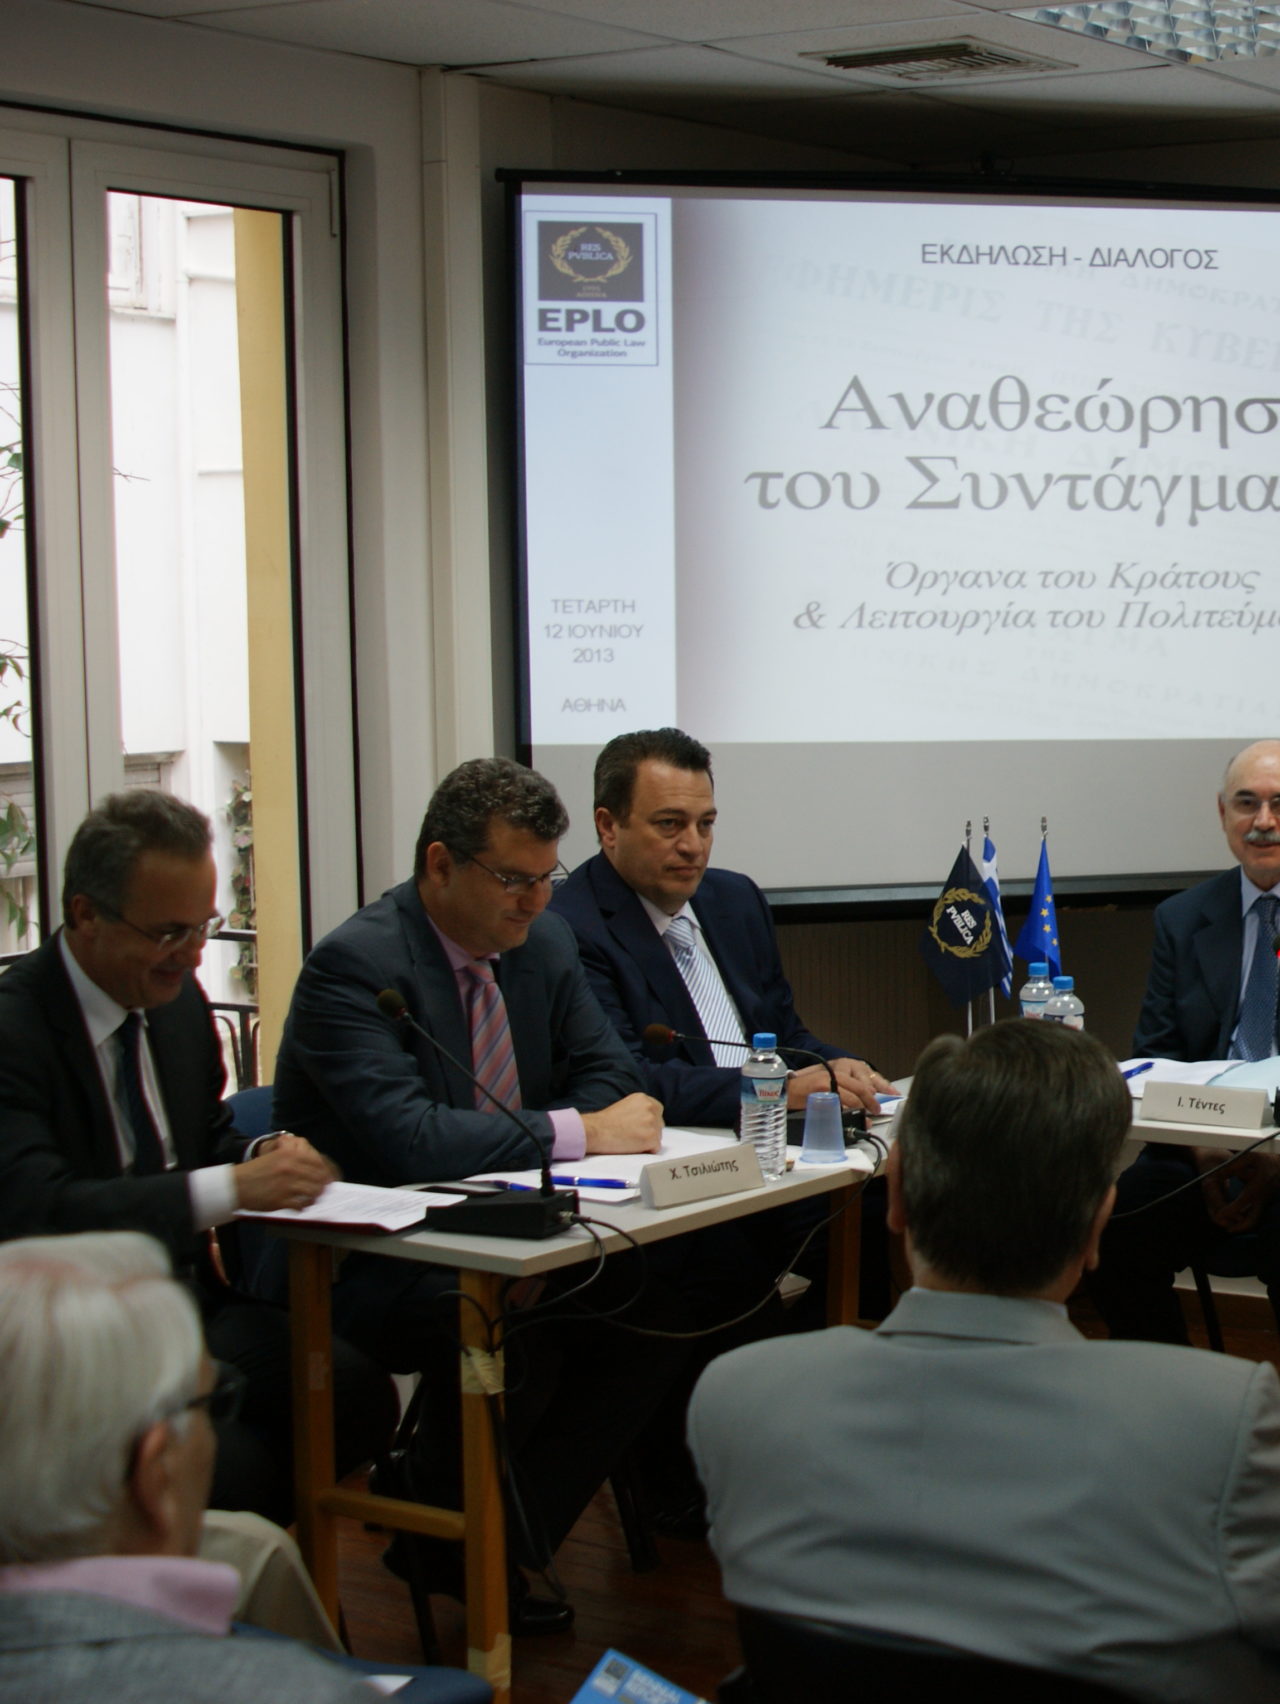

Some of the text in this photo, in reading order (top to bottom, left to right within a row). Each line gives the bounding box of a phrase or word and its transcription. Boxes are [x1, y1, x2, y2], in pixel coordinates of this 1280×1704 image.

[921, 243, 1067, 268] ΕΚΔΗΛΩΣΗ
[1089, 247, 1219, 271] ΔΙΑΛΟΓΟΣ
[537, 308, 646, 334] EPLO
[538, 337, 646, 349] European Public Law
[557, 348, 628, 359] Organization
[744, 470, 880, 511] του
[885, 561, 1262, 596] Όργανα του Κράτους
[551, 599, 636, 614] ΤΕΤΑΡΤΗ
[792, 600, 828, 630] &
[838, 601, 1037, 636] Λειτουργία
[1046, 608, 1106, 630] του
[544, 624, 645, 639] 12 ΙΟΥΝΙΟΥ
[572, 647, 615, 664] 2013
[561, 697, 627, 713] ΑΘΗΝΑ
[1189, 1096, 1226, 1115] Τέντες
[669, 1159, 739, 1180] Χ. Τσιλιώτης
